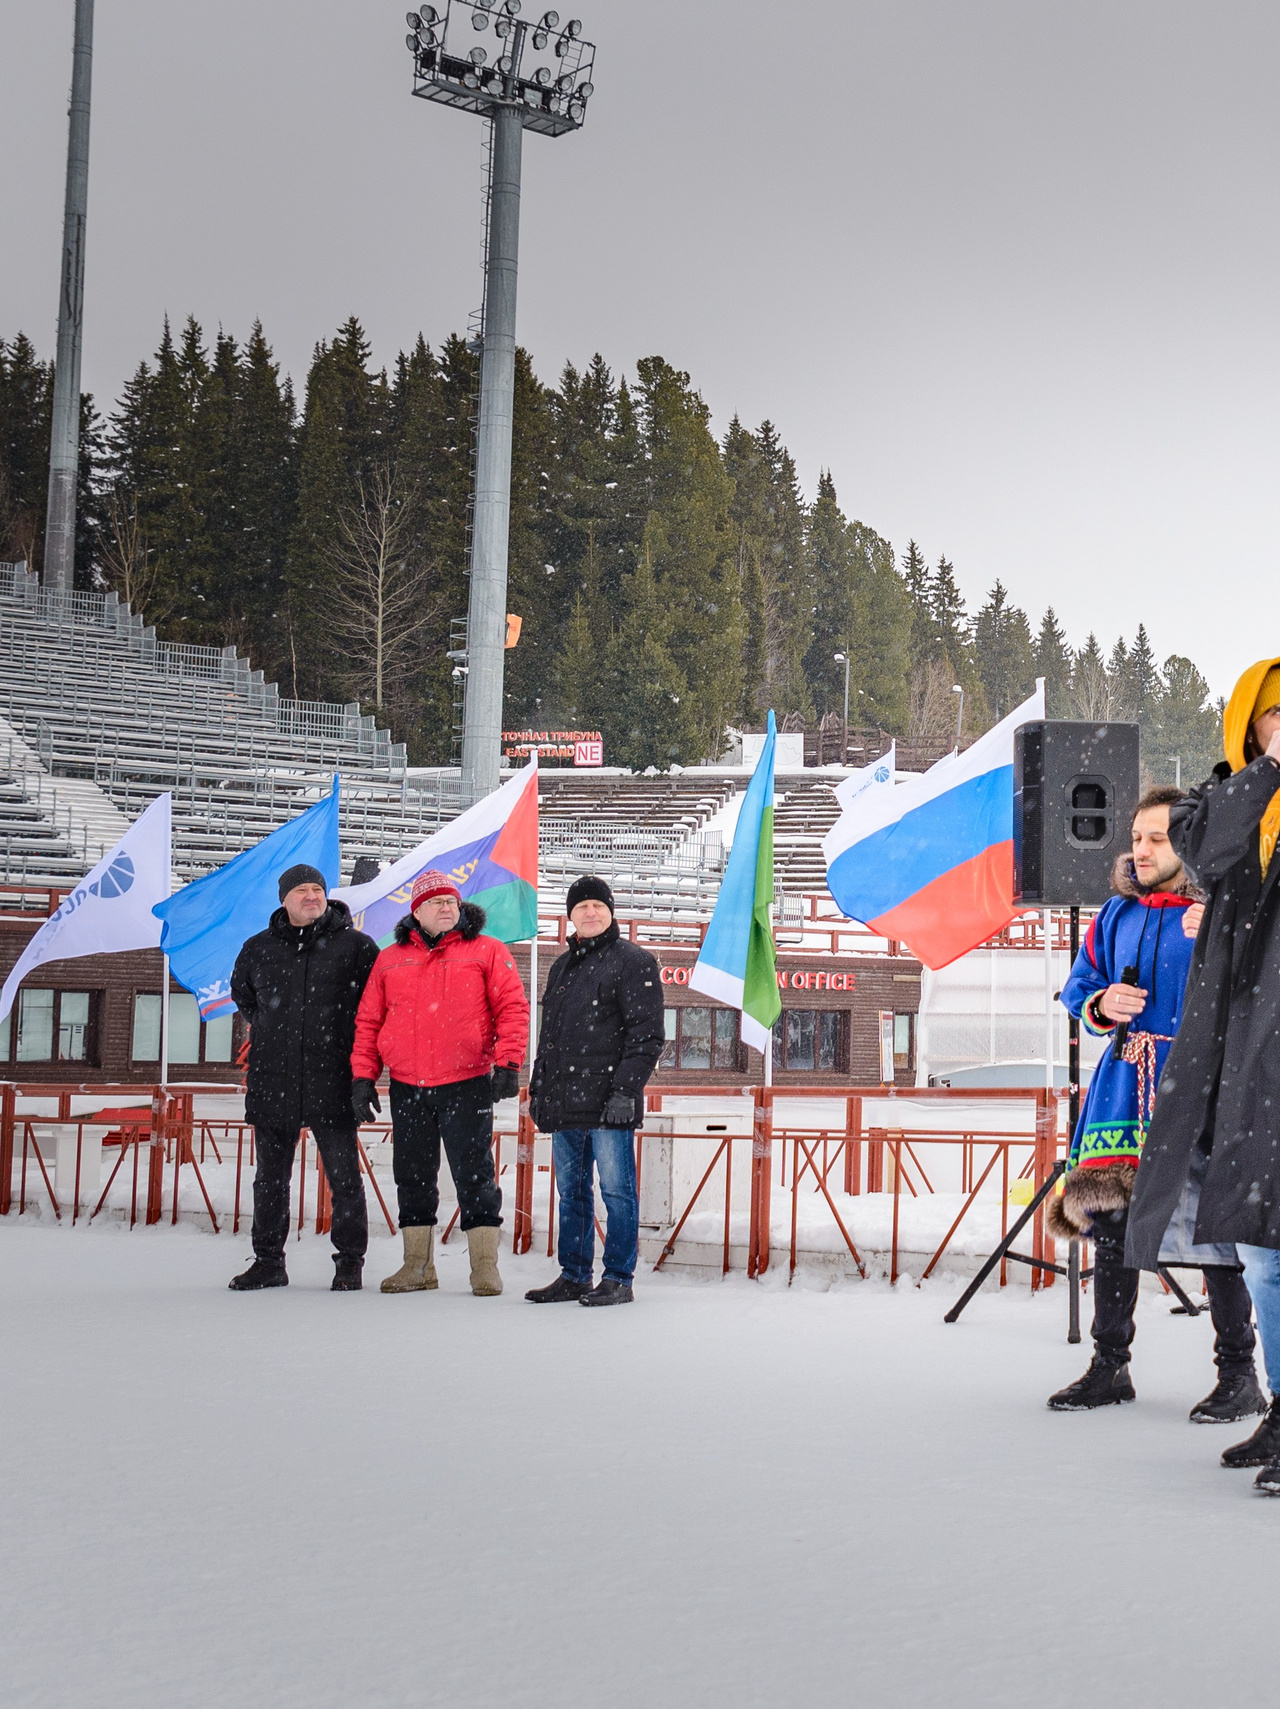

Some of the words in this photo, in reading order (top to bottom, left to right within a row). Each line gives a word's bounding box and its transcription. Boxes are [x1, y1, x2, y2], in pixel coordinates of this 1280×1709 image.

[550, 731, 603, 741] ТРИБУНА
[537, 747, 575, 757] STAND
[577, 745, 600, 761] NE
[791, 971, 856, 991] OFFICE
